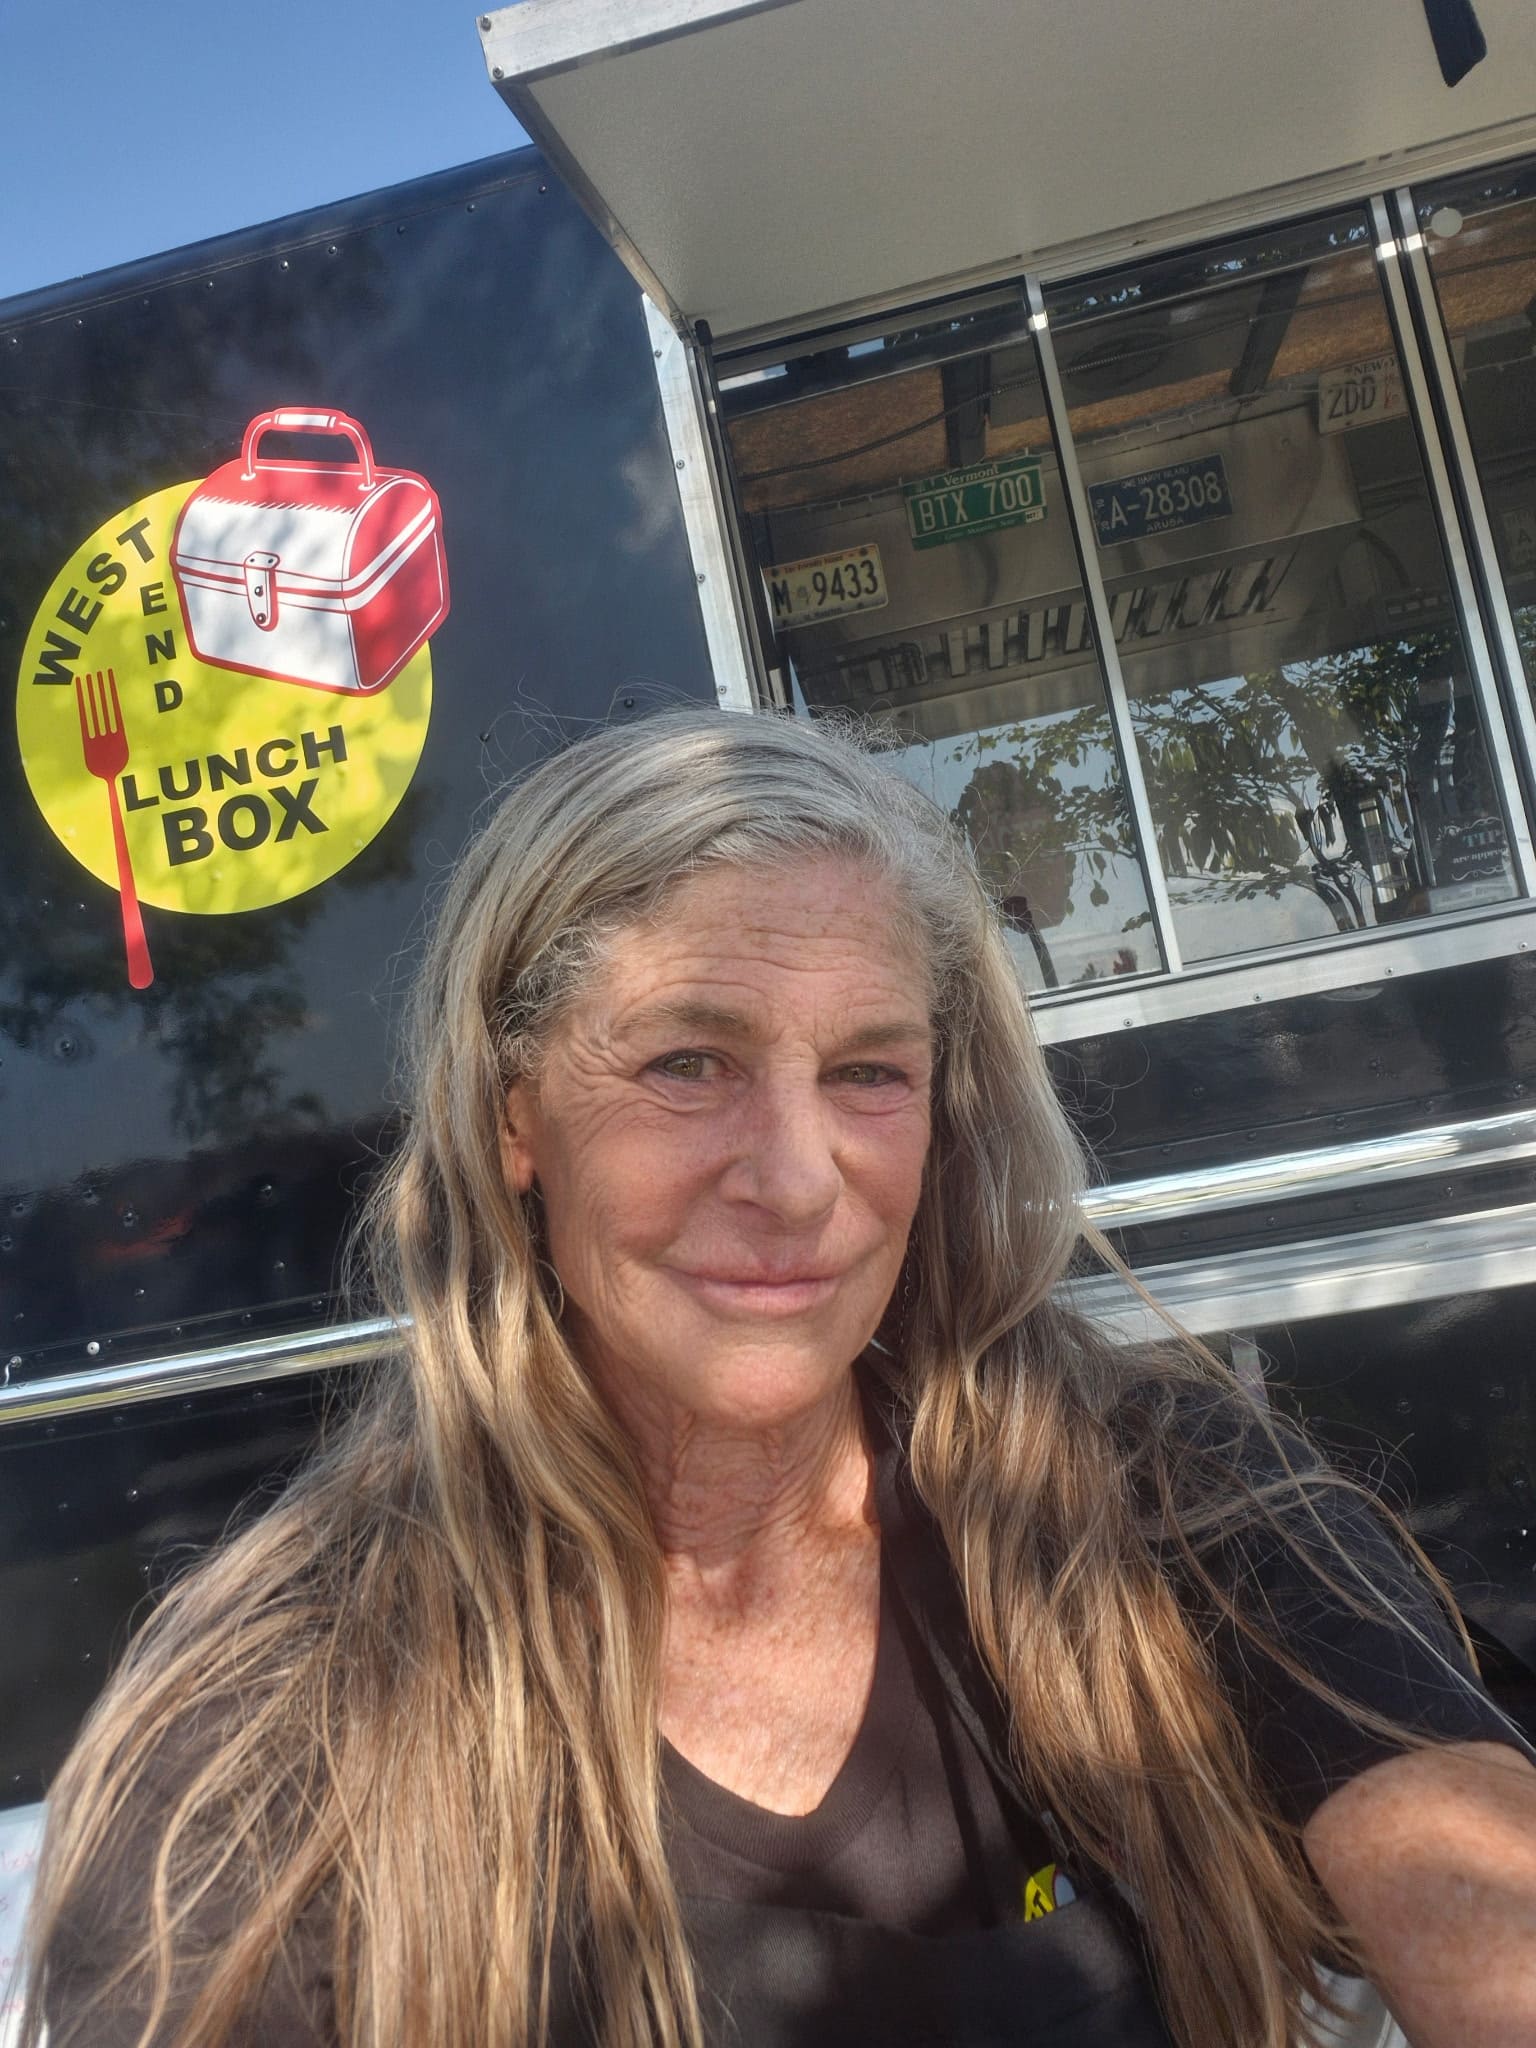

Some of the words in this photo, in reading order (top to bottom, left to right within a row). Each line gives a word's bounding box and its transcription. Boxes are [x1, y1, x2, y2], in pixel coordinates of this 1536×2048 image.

[919, 489, 969, 532] BTX
[982, 474, 1033, 515] 700
[943, 464, 1000, 486] Vermont
[1111, 471, 1223, 529] A-28308
[1146, 517, 1185, 534] ARUBA
[33, 518, 155, 686] WEST
[771, 579, 793, 616] M
[812, 559, 878, 606] 9433
[139, 582, 183, 713] END
[122, 726, 348, 811] LUNCH
[161, 778, 329, 867] BOX
